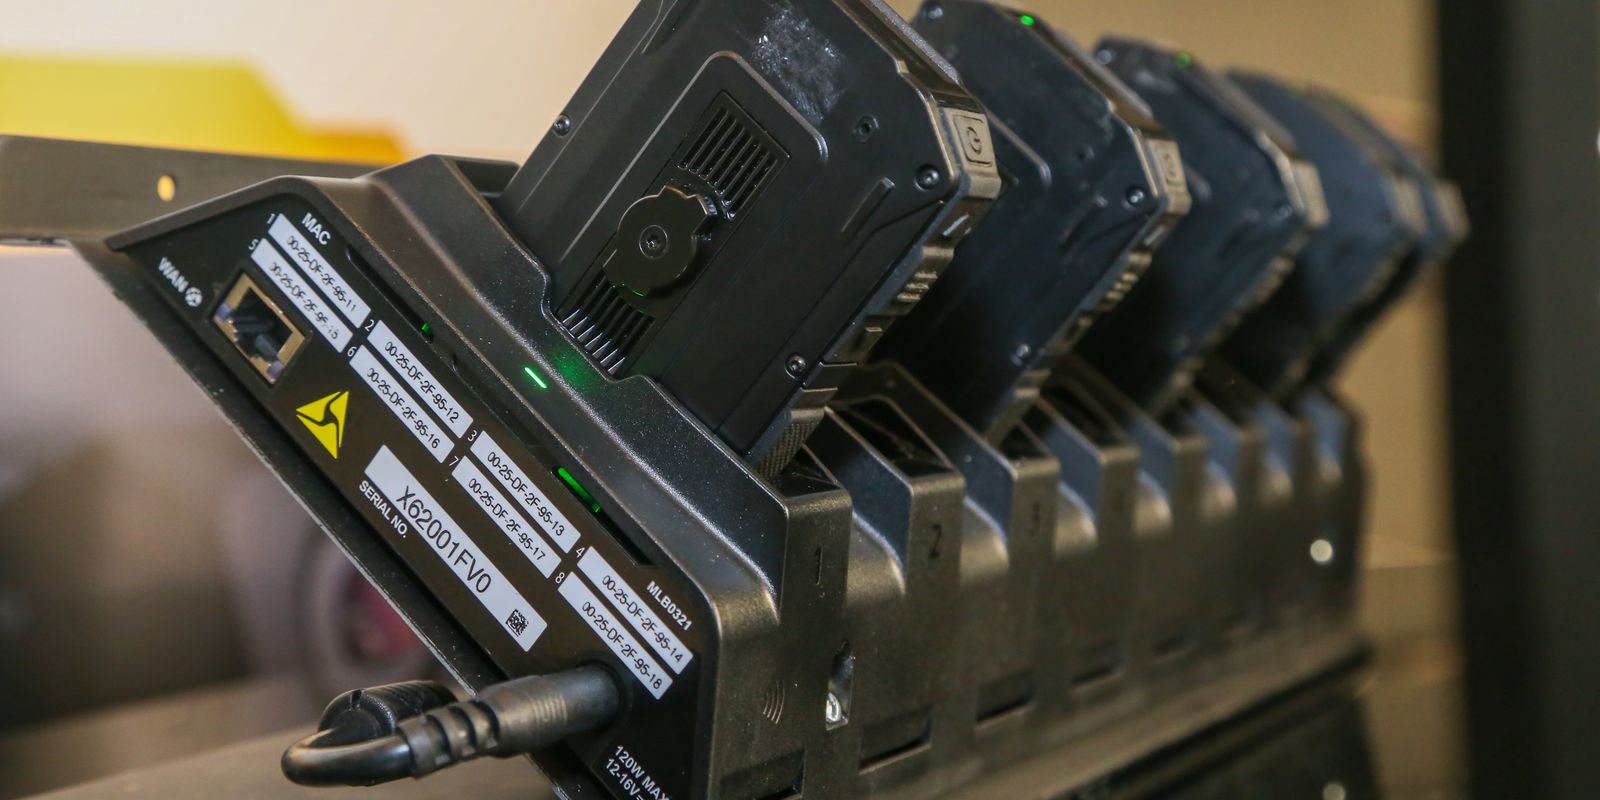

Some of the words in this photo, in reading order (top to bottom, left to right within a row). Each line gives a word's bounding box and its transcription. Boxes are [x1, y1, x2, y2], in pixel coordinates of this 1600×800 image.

[266, 213, 275, 225] 1
[301, 212, 331, 245] MAC
[158, 257, 189, 293] WAN
[364, 319, 375, 331] 2
[347, 346, 357, 357] 6
[384, 341, 460, 424] 00-25-DF-2F-95-12
[366, 368, 441, 449] 00-25-DF-2F-95-16
[467, 430, 477, 442] 3
[448, 456, 459, 467] 7
[359, 480, 391, 521] SERIAL
[390, 514, 408, 539] NO.
[487, 451, 566, 537] 00-25-DF-2F-95-13
[468, 477, 547, 562] 00-25-DF-2F-95-17
[396, 485, 492, 593] X62001FV0
[575, 547, 585, 558] 4
[555, 572, 566, 584] 8
[601, 574, 684, 664] 00-25-DF-2F-95-14
[646, 580, 694, 631] MLB0321
[581, 601, 663, 690] 00-25-DF-2F-95-18
[615, 746, 646, 779] 120W
